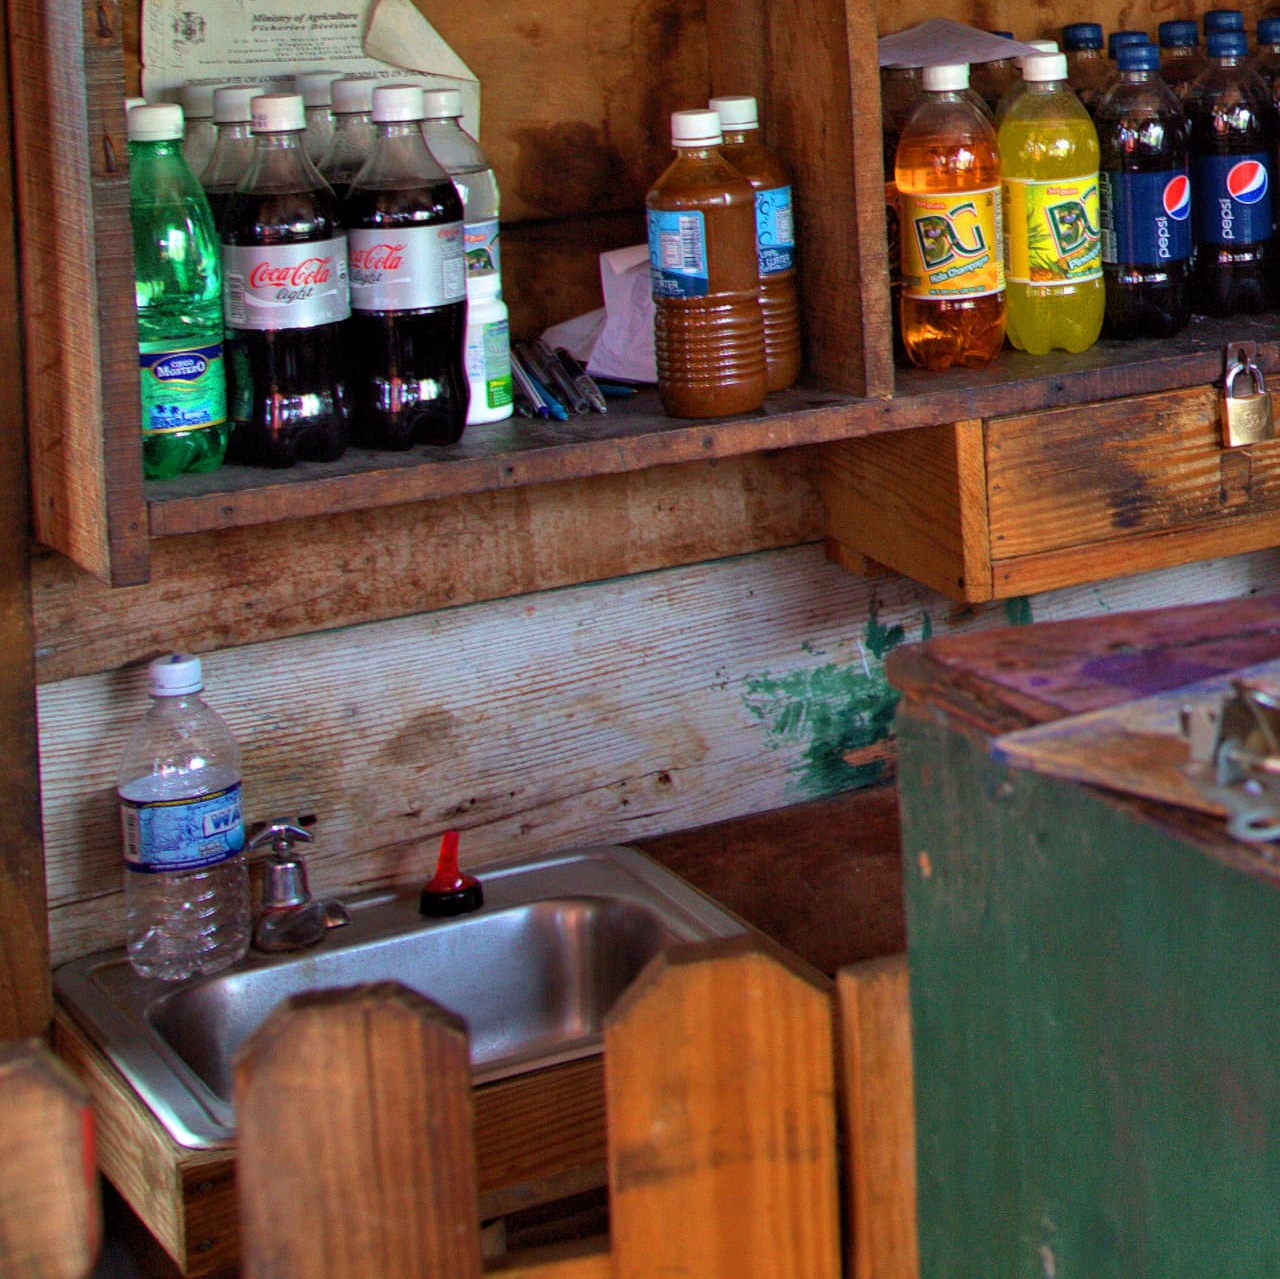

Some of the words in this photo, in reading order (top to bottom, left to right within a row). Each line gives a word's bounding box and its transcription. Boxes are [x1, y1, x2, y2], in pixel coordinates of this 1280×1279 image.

[913, 201, 987, 272] DG
[1158, 215, 1172, 259] pepsi
[1218, 197, 1235, 239] pepsi
[275, 287, 314, 303] light
